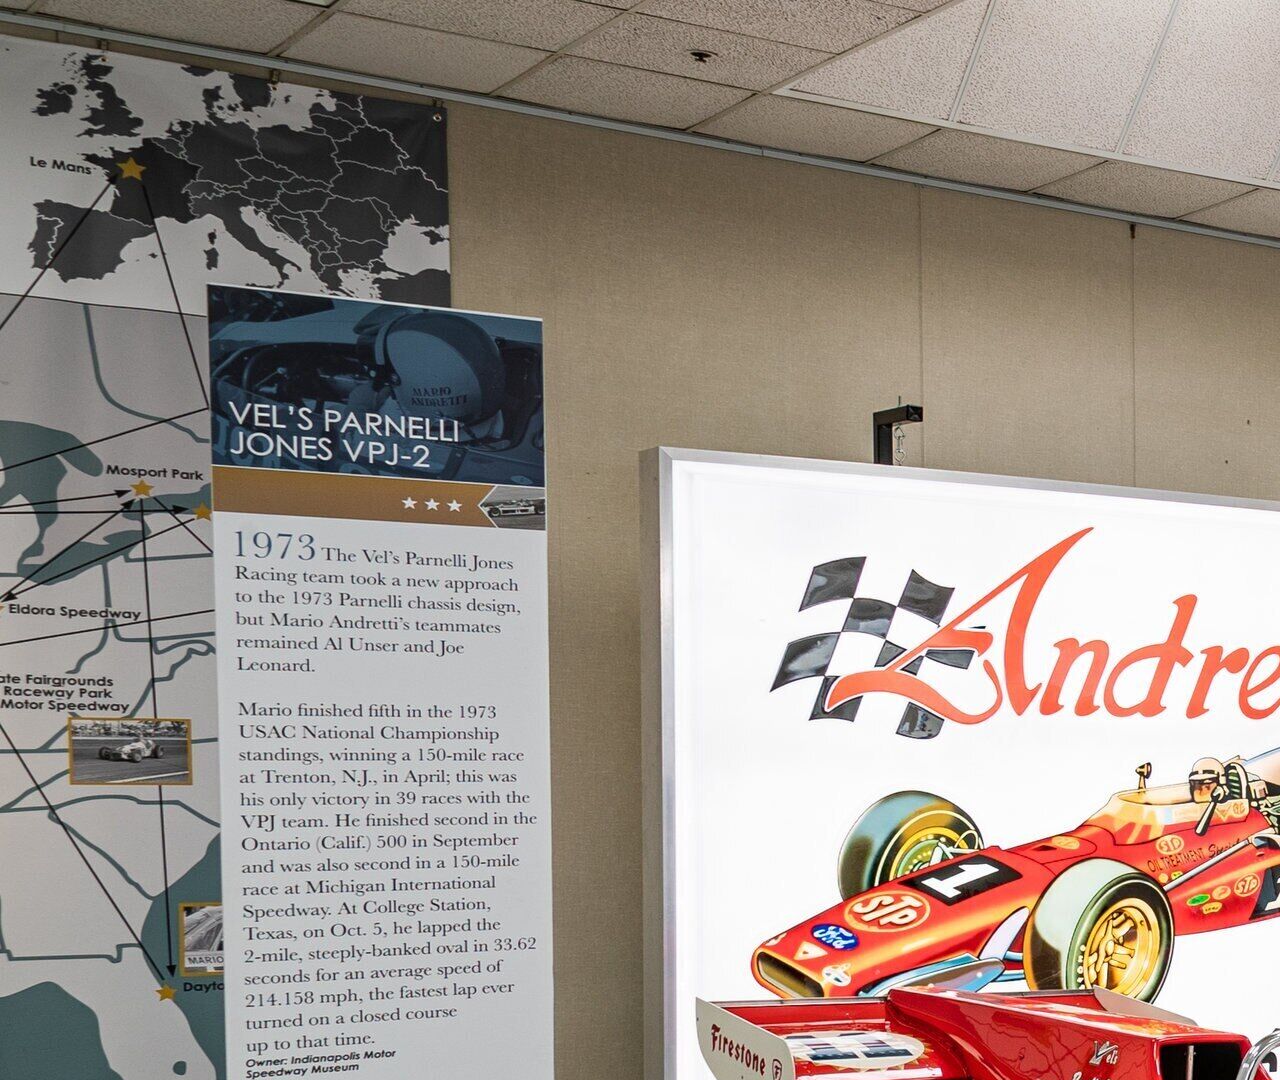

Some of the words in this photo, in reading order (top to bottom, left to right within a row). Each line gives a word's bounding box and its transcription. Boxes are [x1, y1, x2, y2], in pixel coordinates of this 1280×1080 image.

[30, 156, 47, 171] Le
[52, 158, 92, 175] Mans
[228, 401, 313, 430] VEL'S
[325, 409, 459, 442] PARNELLI
[231, 432, 333, 461] JONES
[343, 439, 430, 468] VPJ-2
[106, 464, 167, 479] Mosport
[172, 468, 203, 481] Park
[235, 531, 316, 561] 1973
[321, 547, 357, 562] The
[362, 549, 400, 565] Vel's
[406, 551, 467, 568] Parnelli
[468, 555, 513, 572] Jones
[235, 566, 297, 585] Racing
[303, 570, 344, 584] team
[350, 573, 385, 586] took
[392, 577, 401, 587] a
[407, 578, 440, 588] new
[445, 578, 519, 593] approach
[9, 604, 55, 616] Eldora
[60, 606, 141, 621] Speedway
[26, 674, 113, 689] Fairgrounds
[4, 687, 74, 699] Raceway
[79, 687, 112, 699] Park
[1, 699, 44, 711] Motor
[49, 700, 129, 713] Speedway
[921, 861, 1000, 899] 1
[851, 894, 924, 927] STP
[813, 924, 856, 949] Ford
[246, 1058, 287, 1069] Owner:
[291, 1052, 361, 1065] Indianapolis
[363, 1049, 396, 1059] Motor
[711, 1023, 766, 1077] Firestone
[246, 1068, 307, 1080] Speedway
[311, 1063, 359, 1074] Museum
